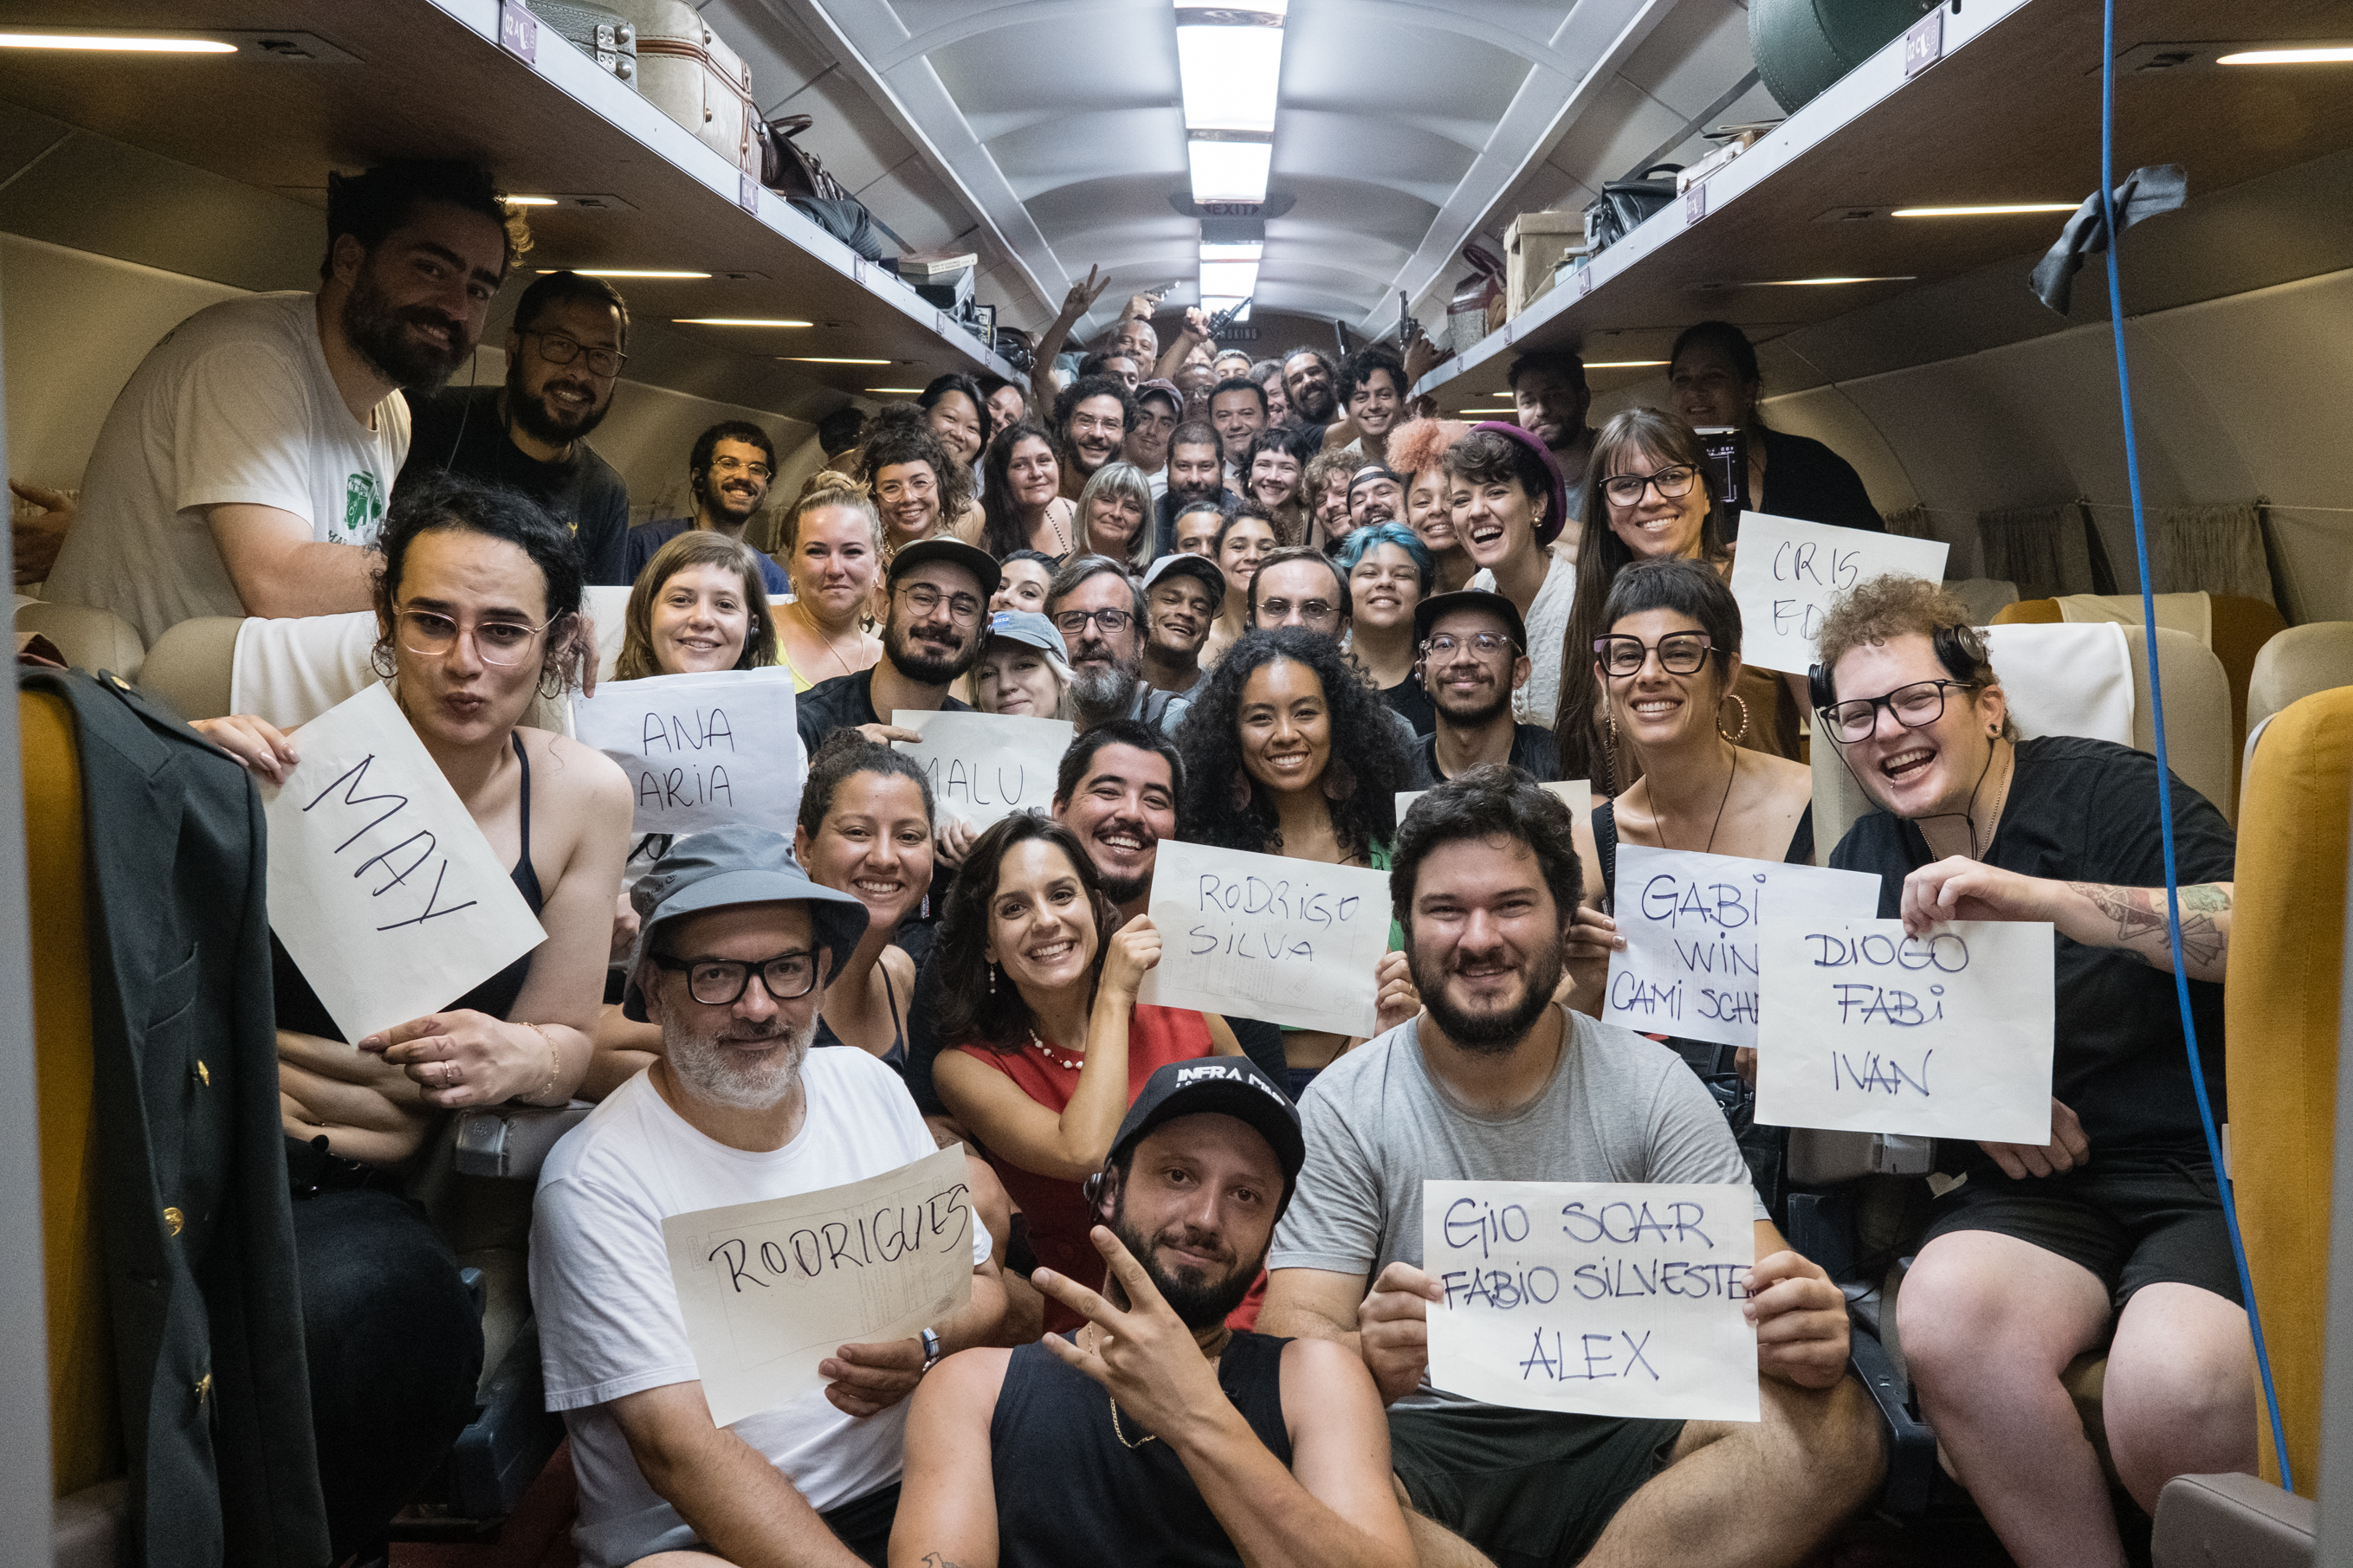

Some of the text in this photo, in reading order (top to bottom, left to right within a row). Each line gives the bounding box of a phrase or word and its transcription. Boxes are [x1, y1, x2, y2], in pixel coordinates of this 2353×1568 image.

[1212, 203, 1251, 216] EXIT
[1217, 328, 1257, 340] OKING
[1773, 540, 1861, 590] CRIS
[643, 708, 735, 757] ANA
[301, 752, 478, 932] MAY
[1177, 1065, 1243, 1083] INFRA
[1832, 1048, 1934, 1097] IVAN
[708, 1183, 970, 1293] RODRIGUES
[1519, 1326, 1660, 1383] ALEX
